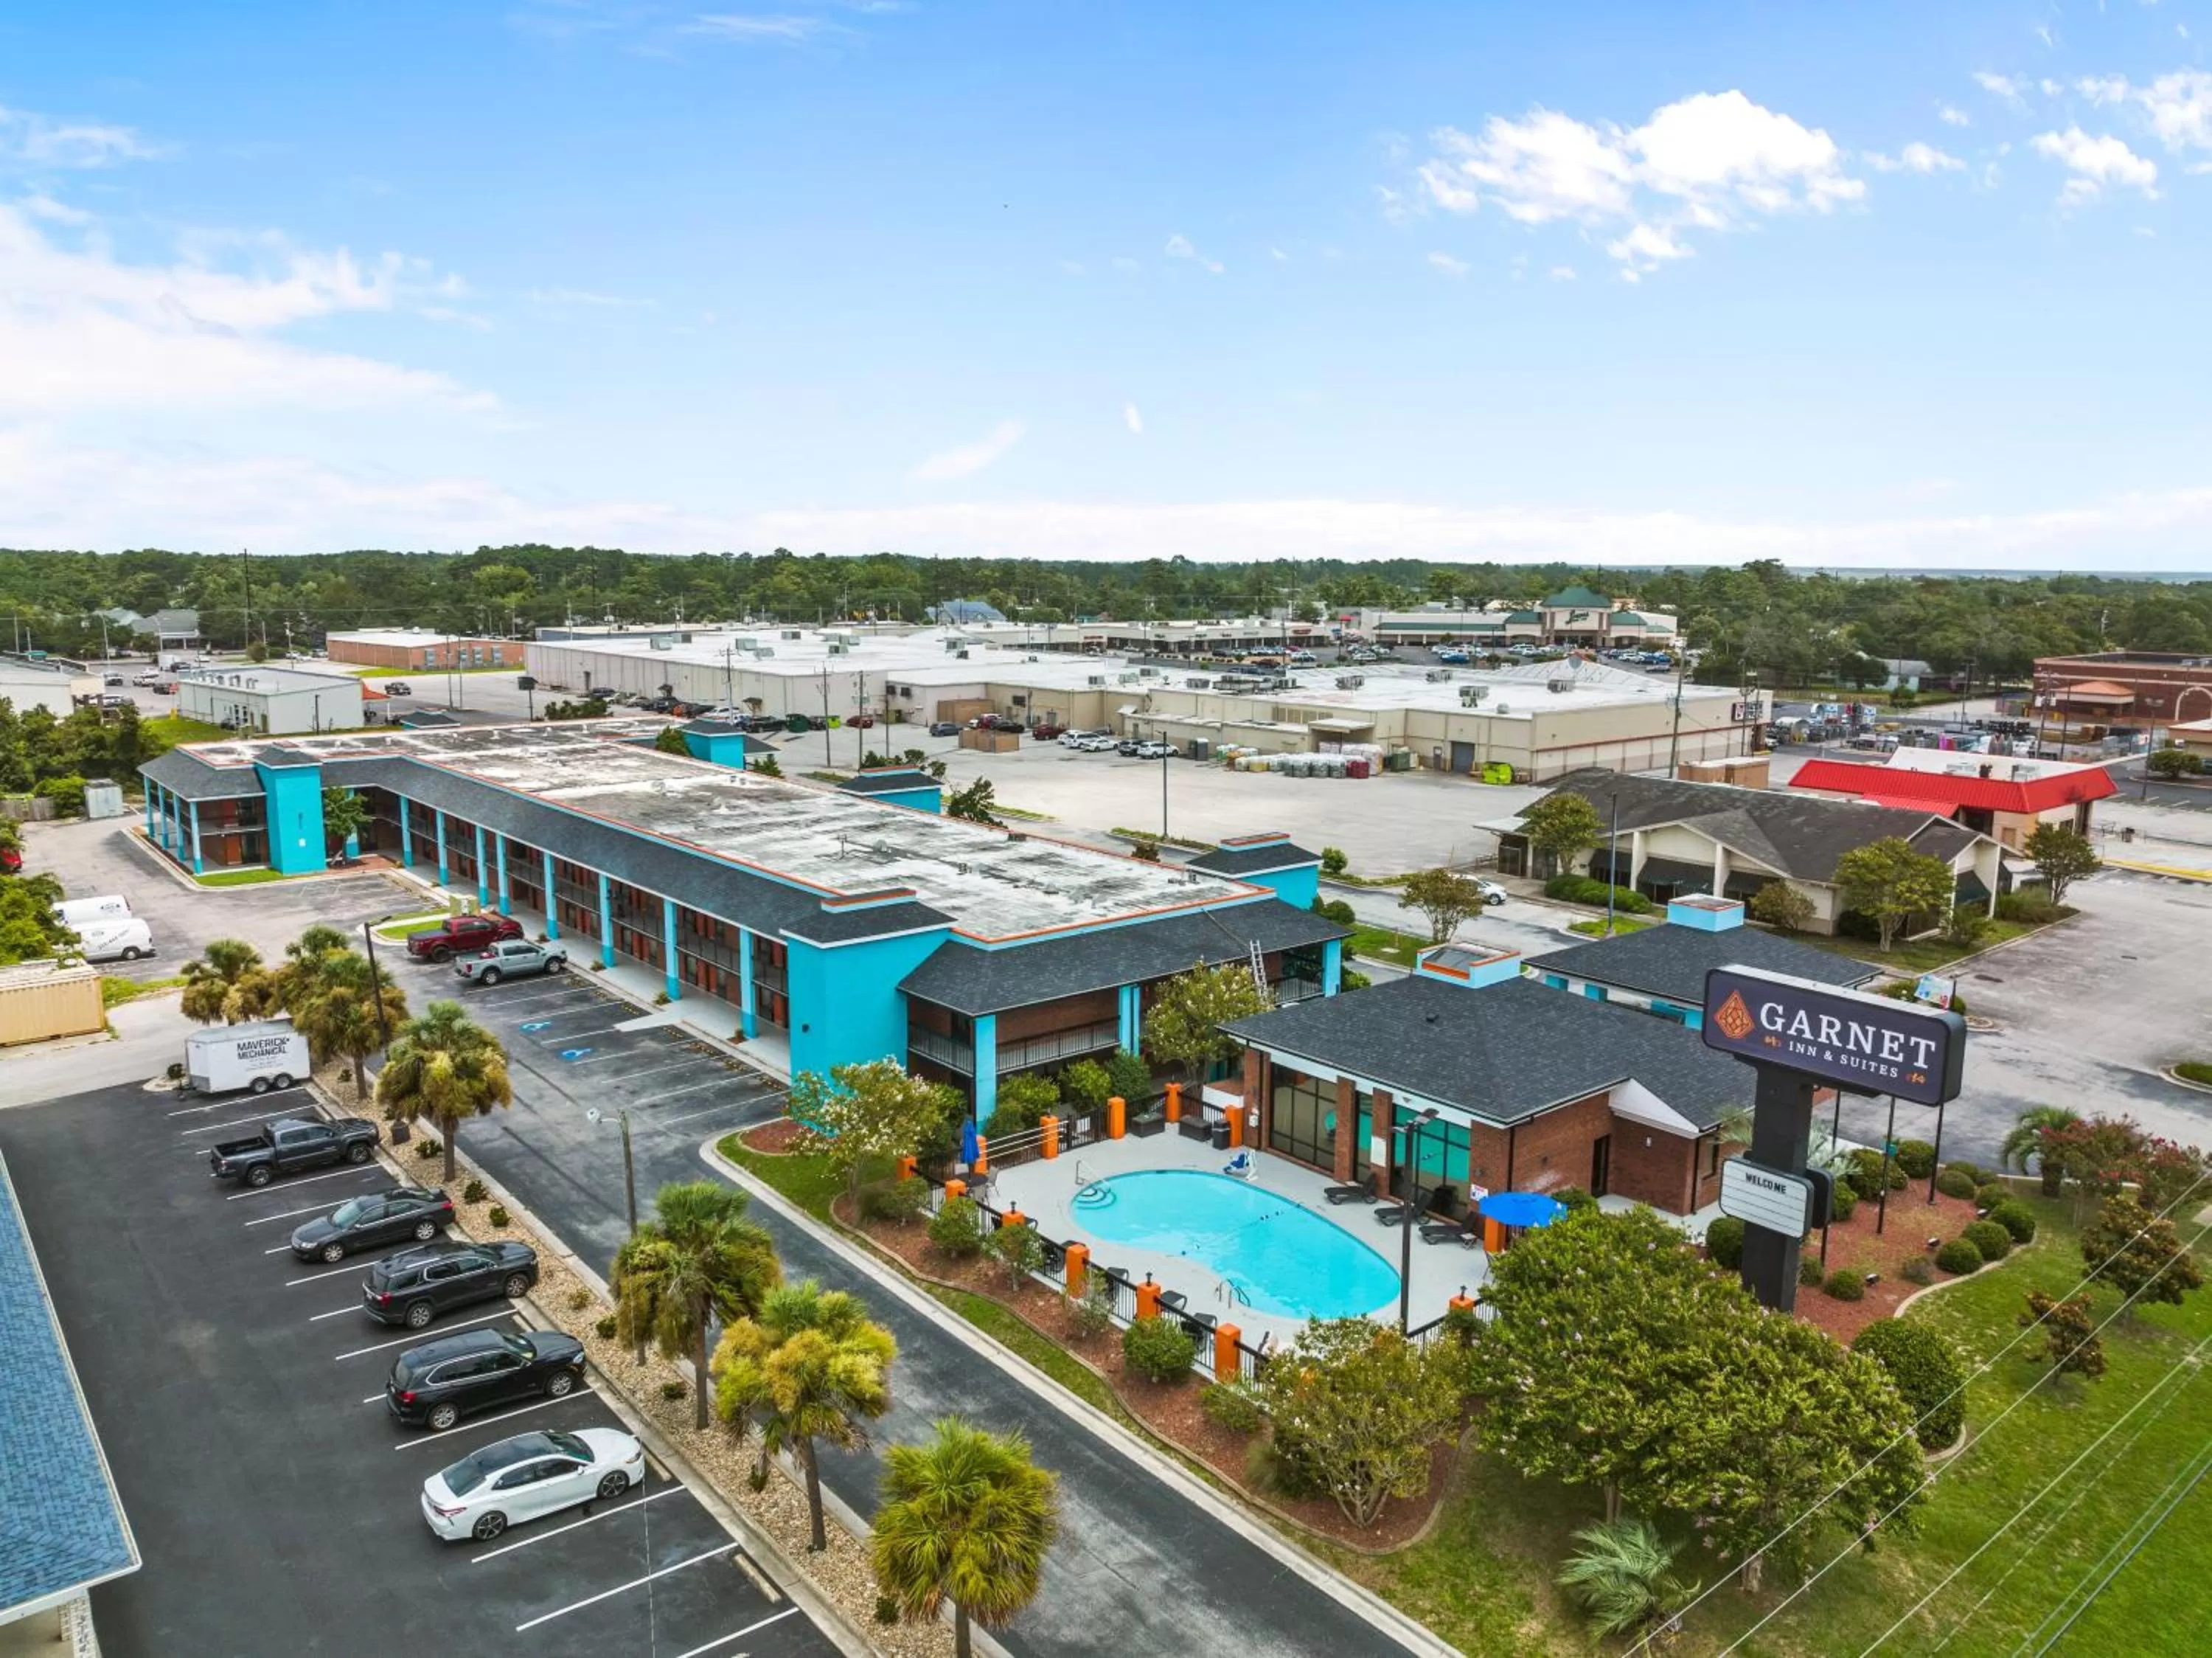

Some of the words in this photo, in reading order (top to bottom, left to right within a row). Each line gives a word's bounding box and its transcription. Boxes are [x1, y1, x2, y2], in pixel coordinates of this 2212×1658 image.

[237, 1038, 287, 1051] MAVERICK
[1760, 1002, 1935, 1069] GARNET
[237, 1045, 288, 1060] MECHANICAL
[1789, 1041, 1817, 1057] INN
[1823, 1050, 1834, 1061] &
[1840, 1055, 1899, 1078] SUITES
[1745, 1172, 1787, 1195] WELCOME
